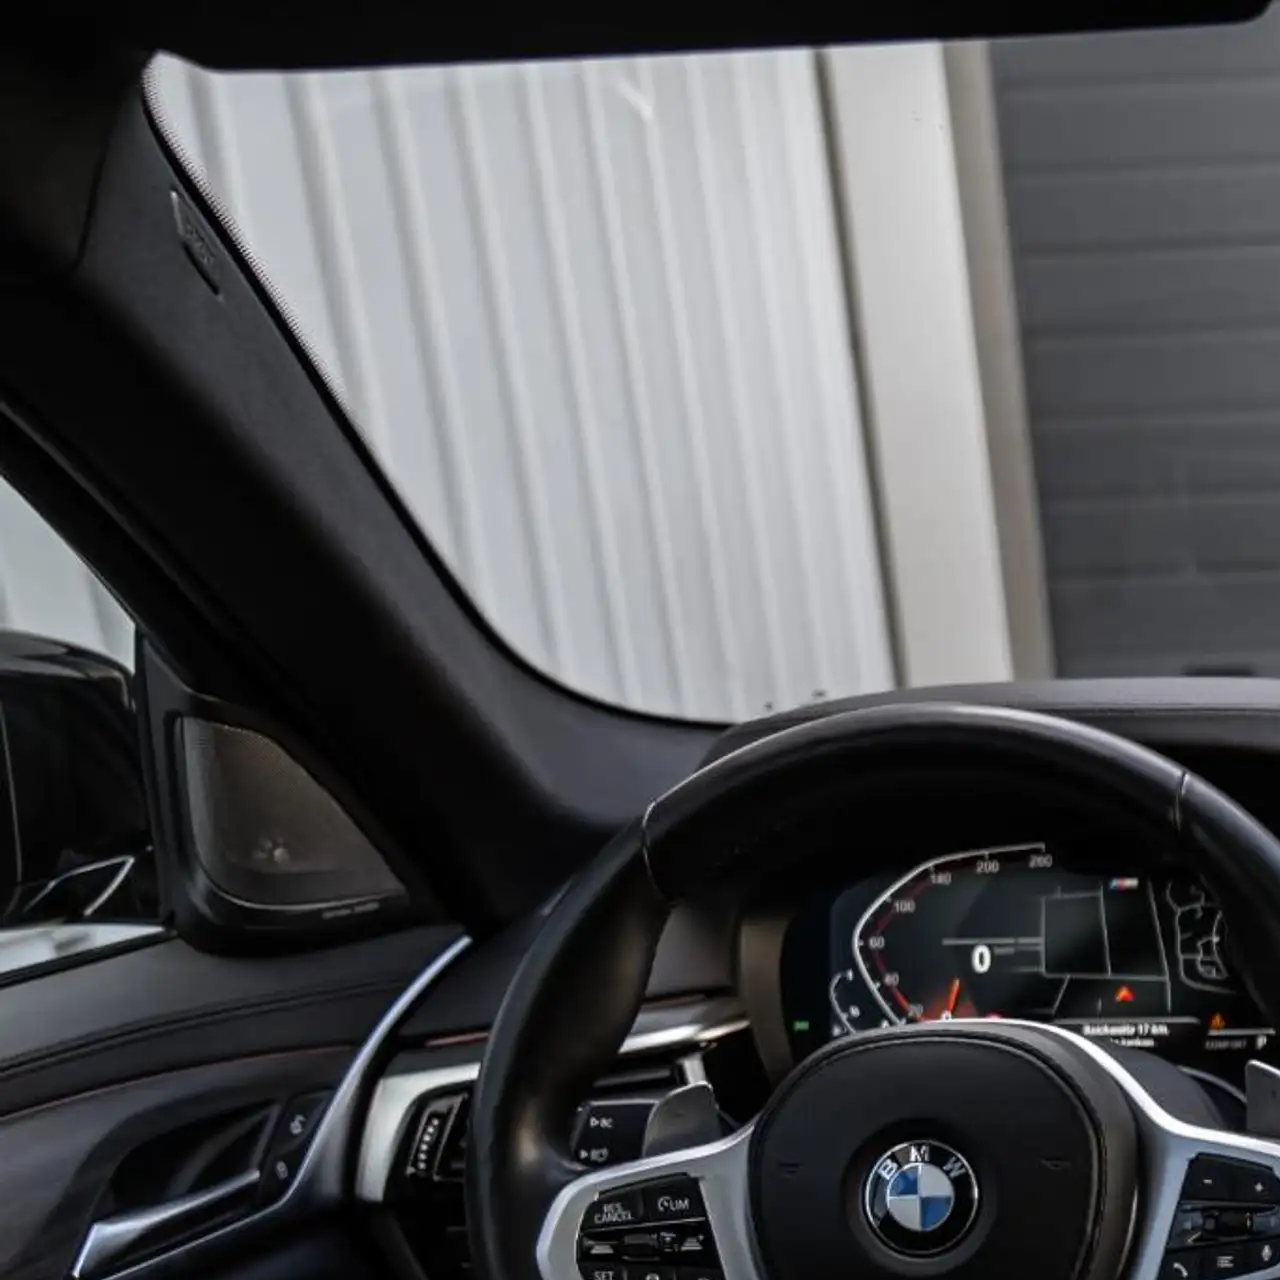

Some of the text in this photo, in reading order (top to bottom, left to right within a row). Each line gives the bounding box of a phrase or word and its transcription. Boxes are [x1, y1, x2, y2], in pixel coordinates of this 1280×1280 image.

[976, 861, 999, 873] 200
[895, 899, 916, 912] 100
[972, 945, 991, 973] 0
[878, 1145, 967, 1180] BMW
